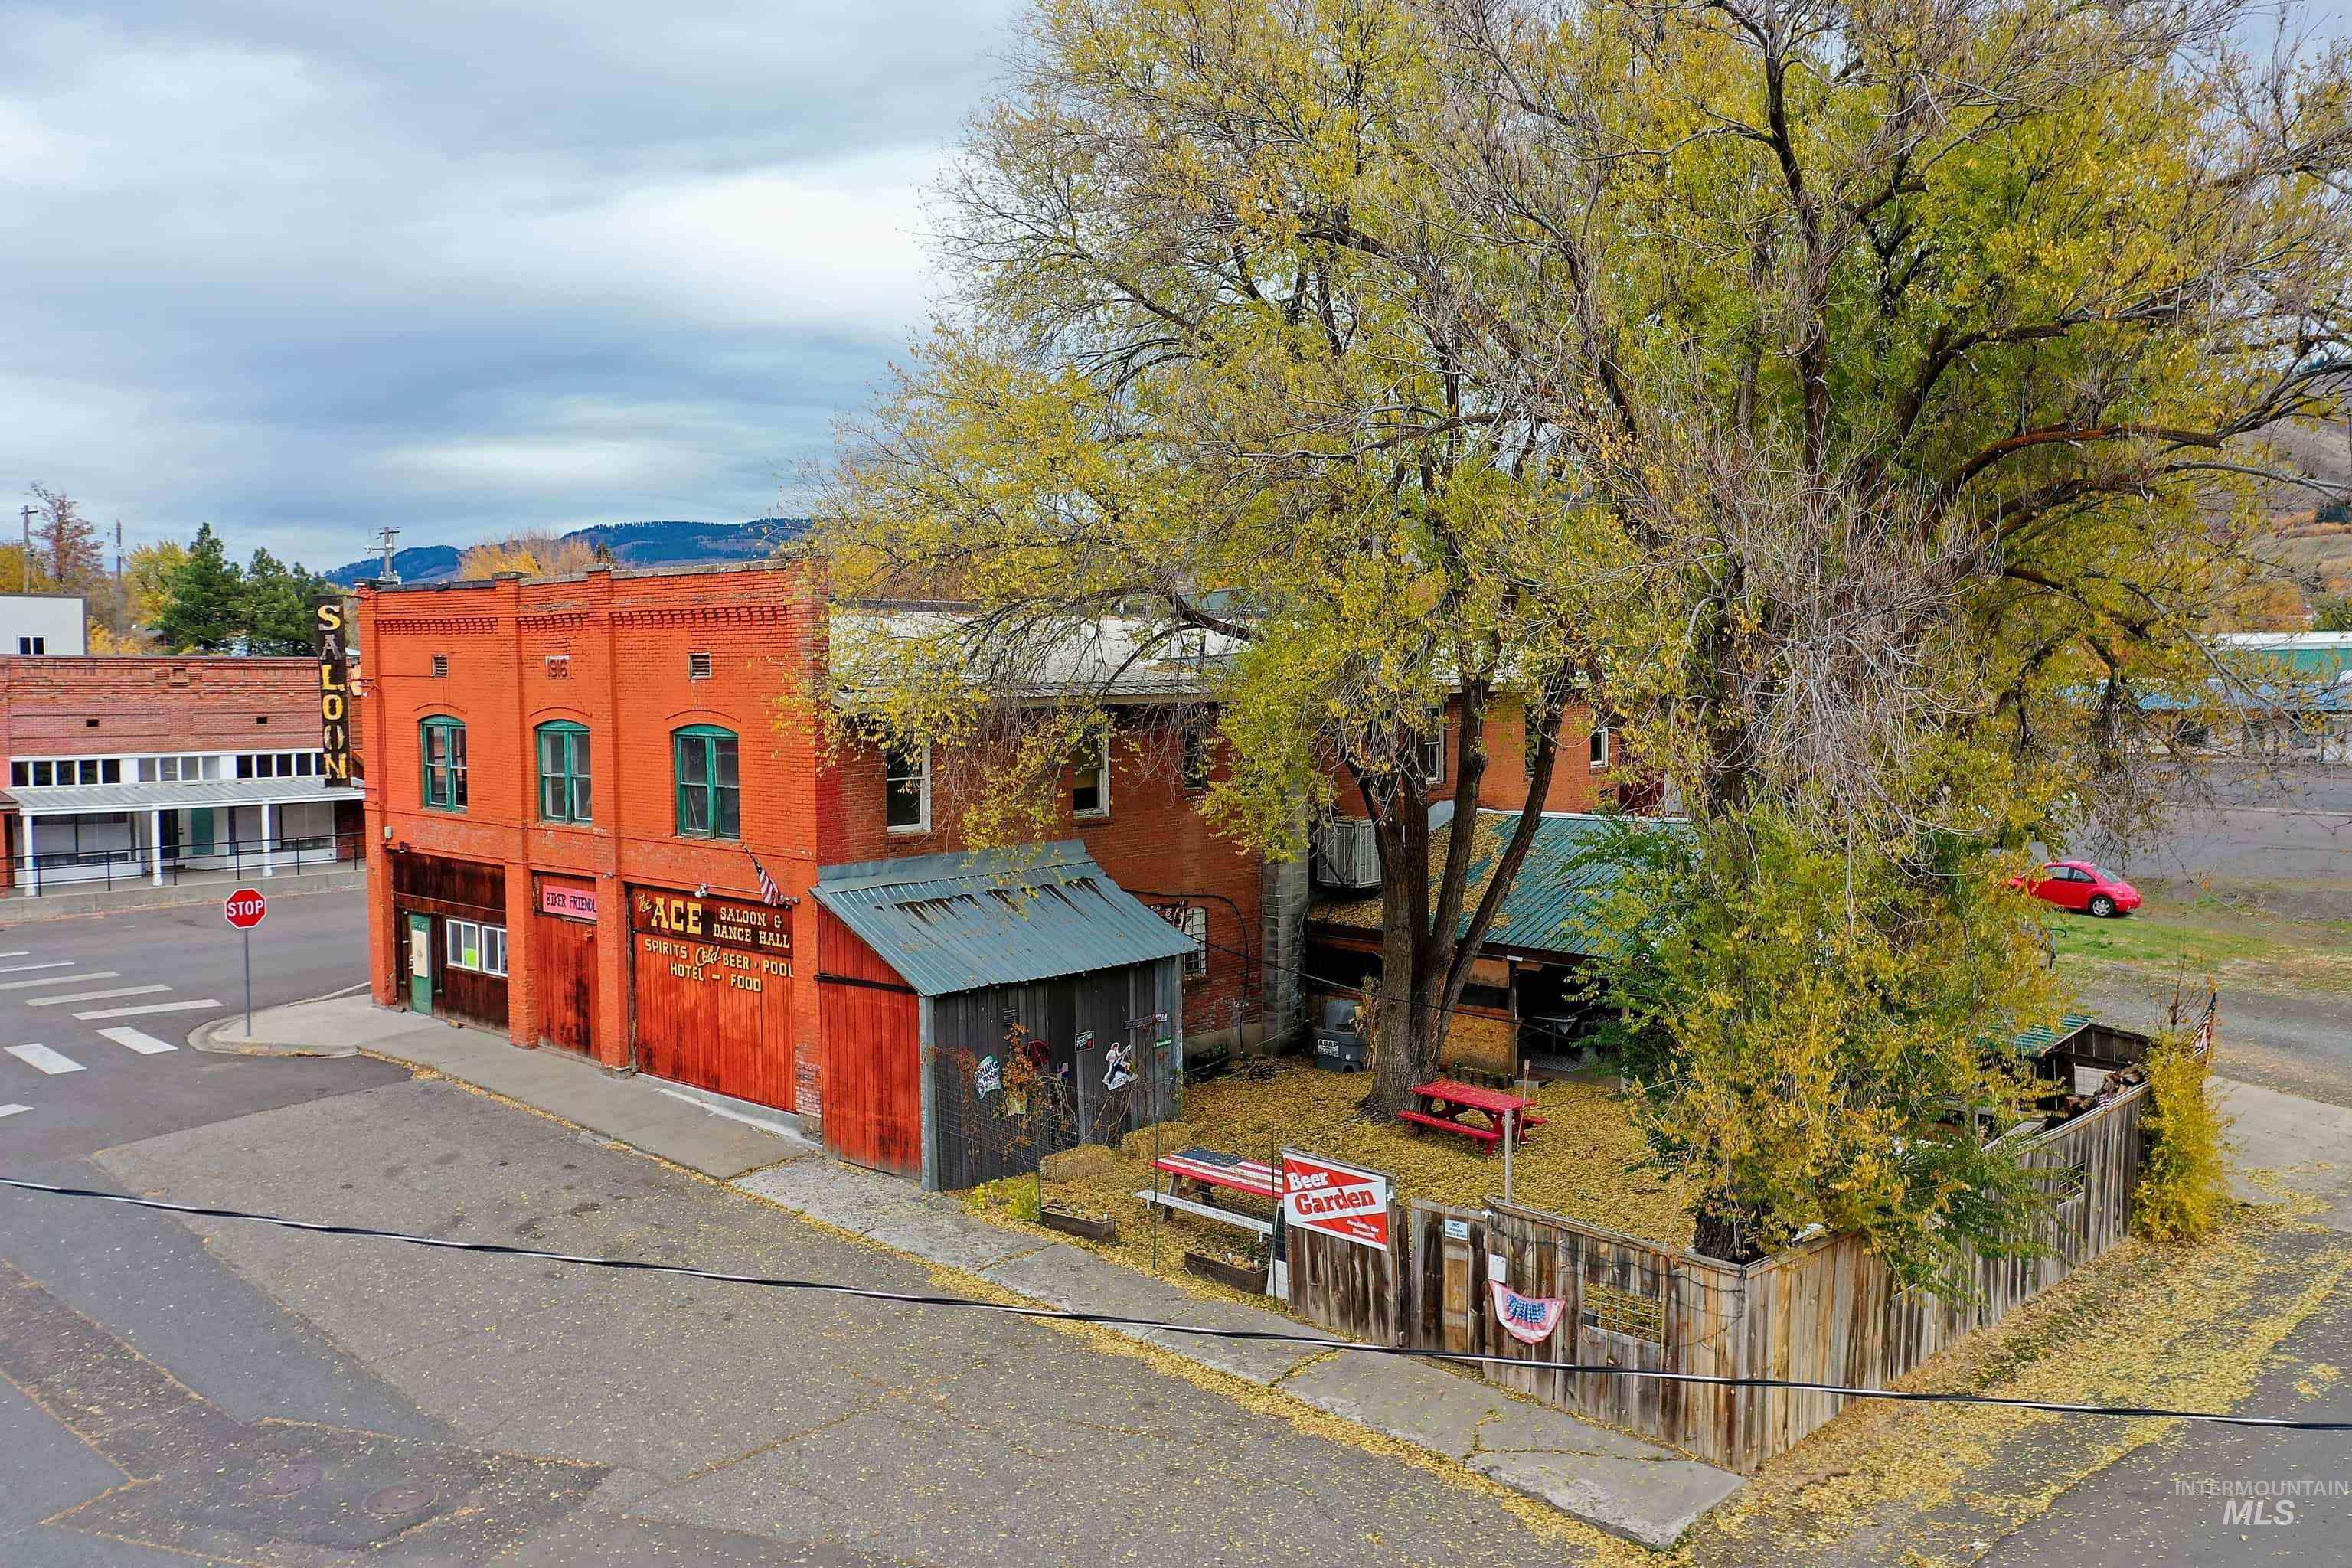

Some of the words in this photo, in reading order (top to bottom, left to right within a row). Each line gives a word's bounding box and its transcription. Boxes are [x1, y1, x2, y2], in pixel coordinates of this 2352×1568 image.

[317, 604, 348, 779] SALOON
[227, 900, 264, 917] STOP
[546, 892, 567, 908] BIKER
[650, 897, 701, 935] ACE
[720, 906, 766, 926] SALOON
[774, 915, 782, 929] &
[713, 923, 752, 942] DANCE
[759, 930, 790, 949] HALL
[645, 939, 687, 959] SPIRITS
[695, 945, 722, 967] Cold
[722, 952, 750, 970] BEER
[763, 959, 794, 978] POOL
[670, 962, 704, 982] HOTEL
[730, 974, 762, 992] FOOD
[1287, 1171, 1328, 1191] Beer
[1295, 1187, 1376, 1216] Garden
